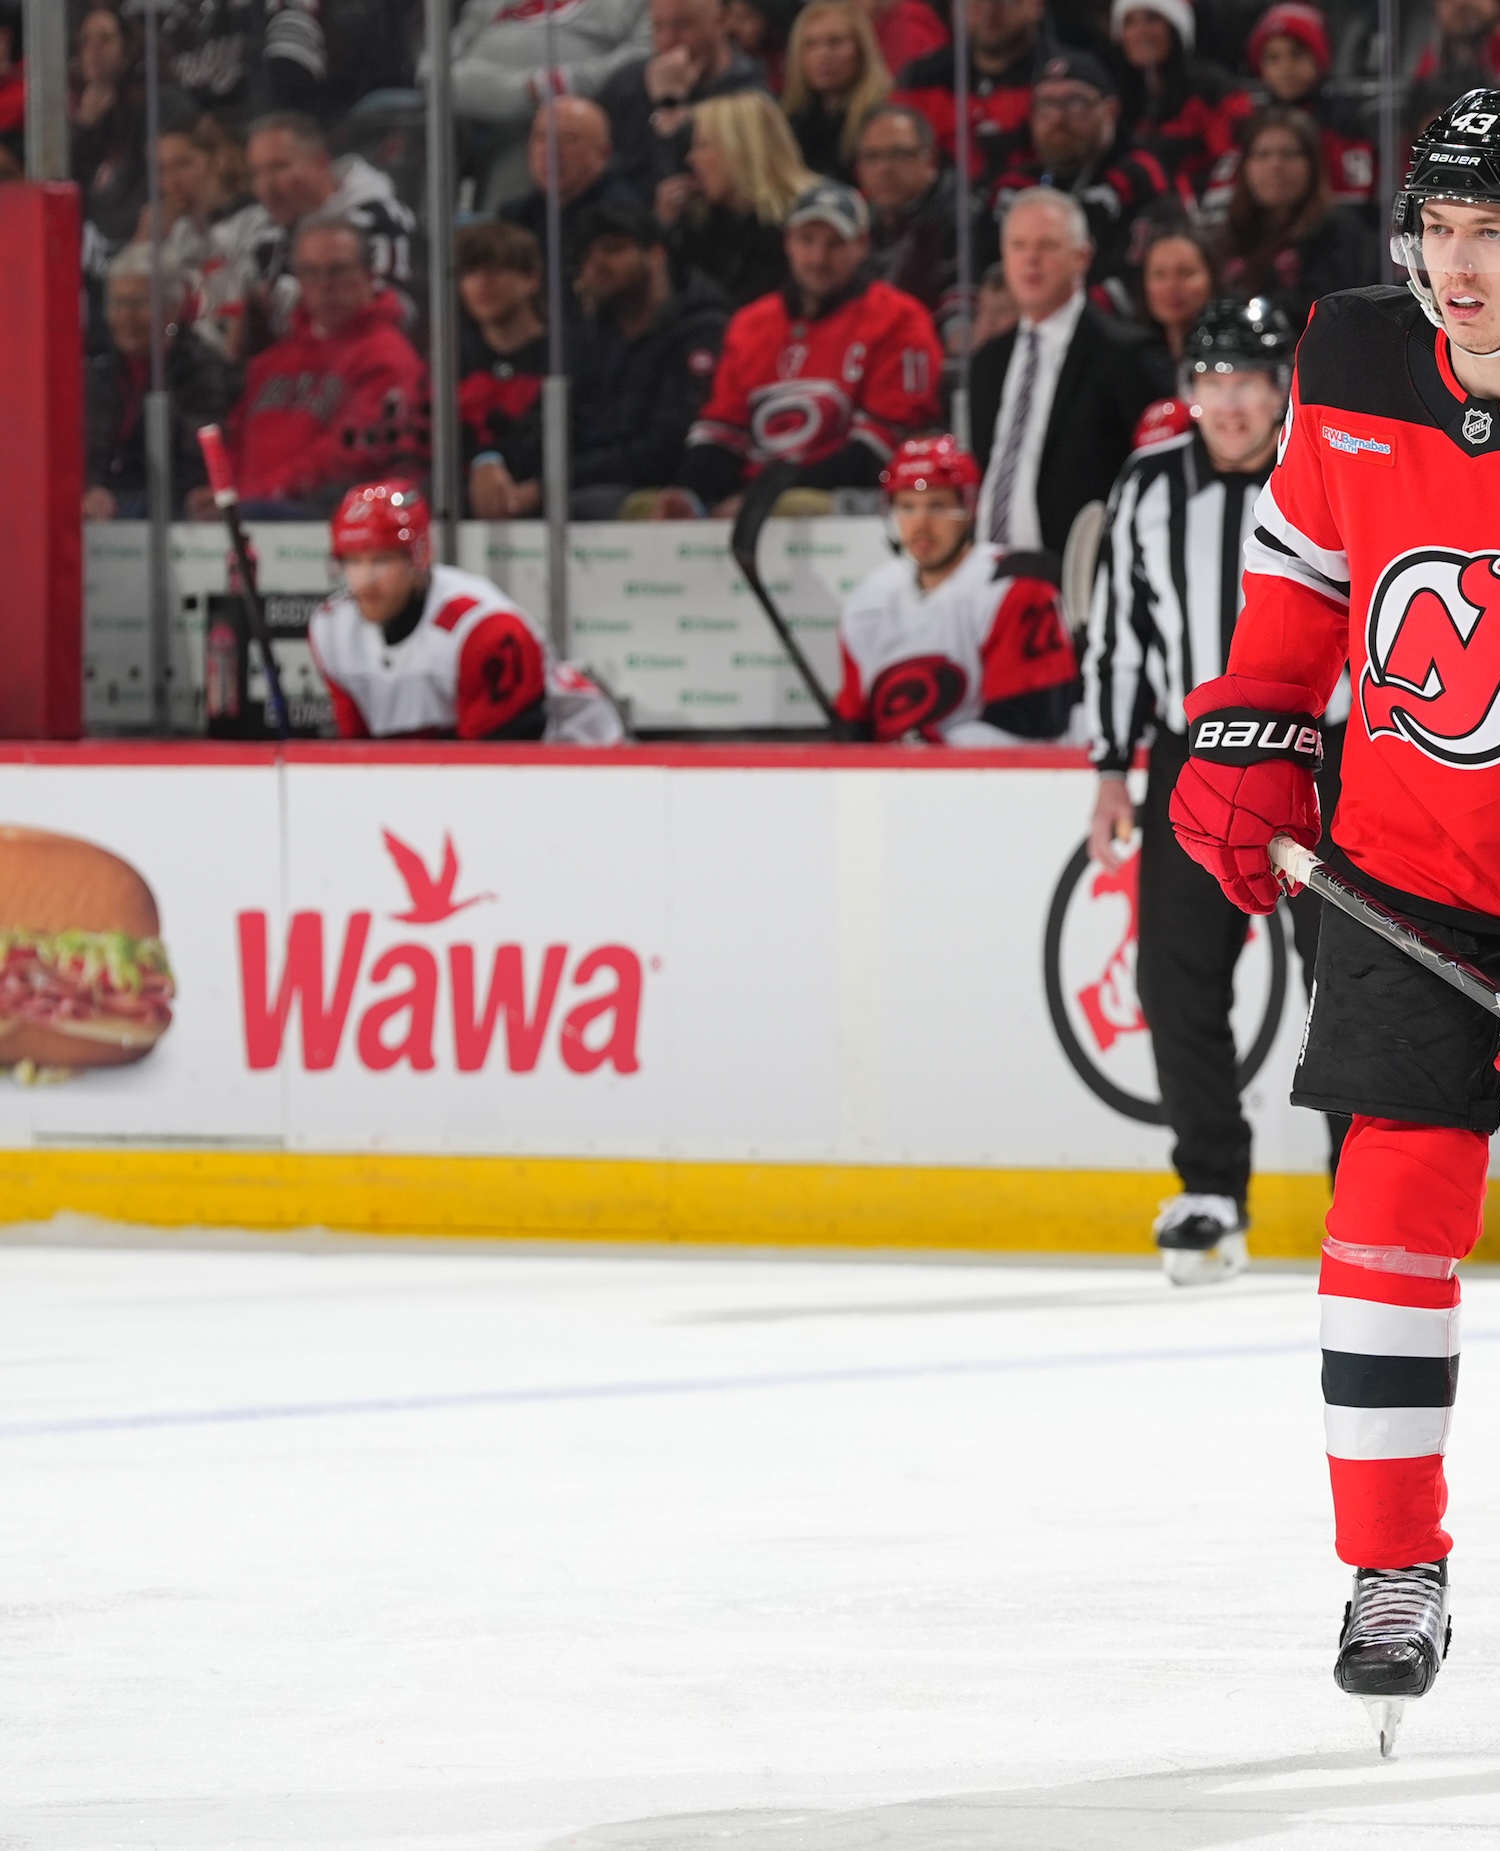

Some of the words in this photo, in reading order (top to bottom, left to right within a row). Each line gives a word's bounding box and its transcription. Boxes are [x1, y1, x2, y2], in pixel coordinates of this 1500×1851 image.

[1451, 112, 1499, 135] 43
[1467, 420, 1487, 435] NHL
[1330, 440, 1359, 455] HEALTH
[235, 910, 643, 1078] Wawa
